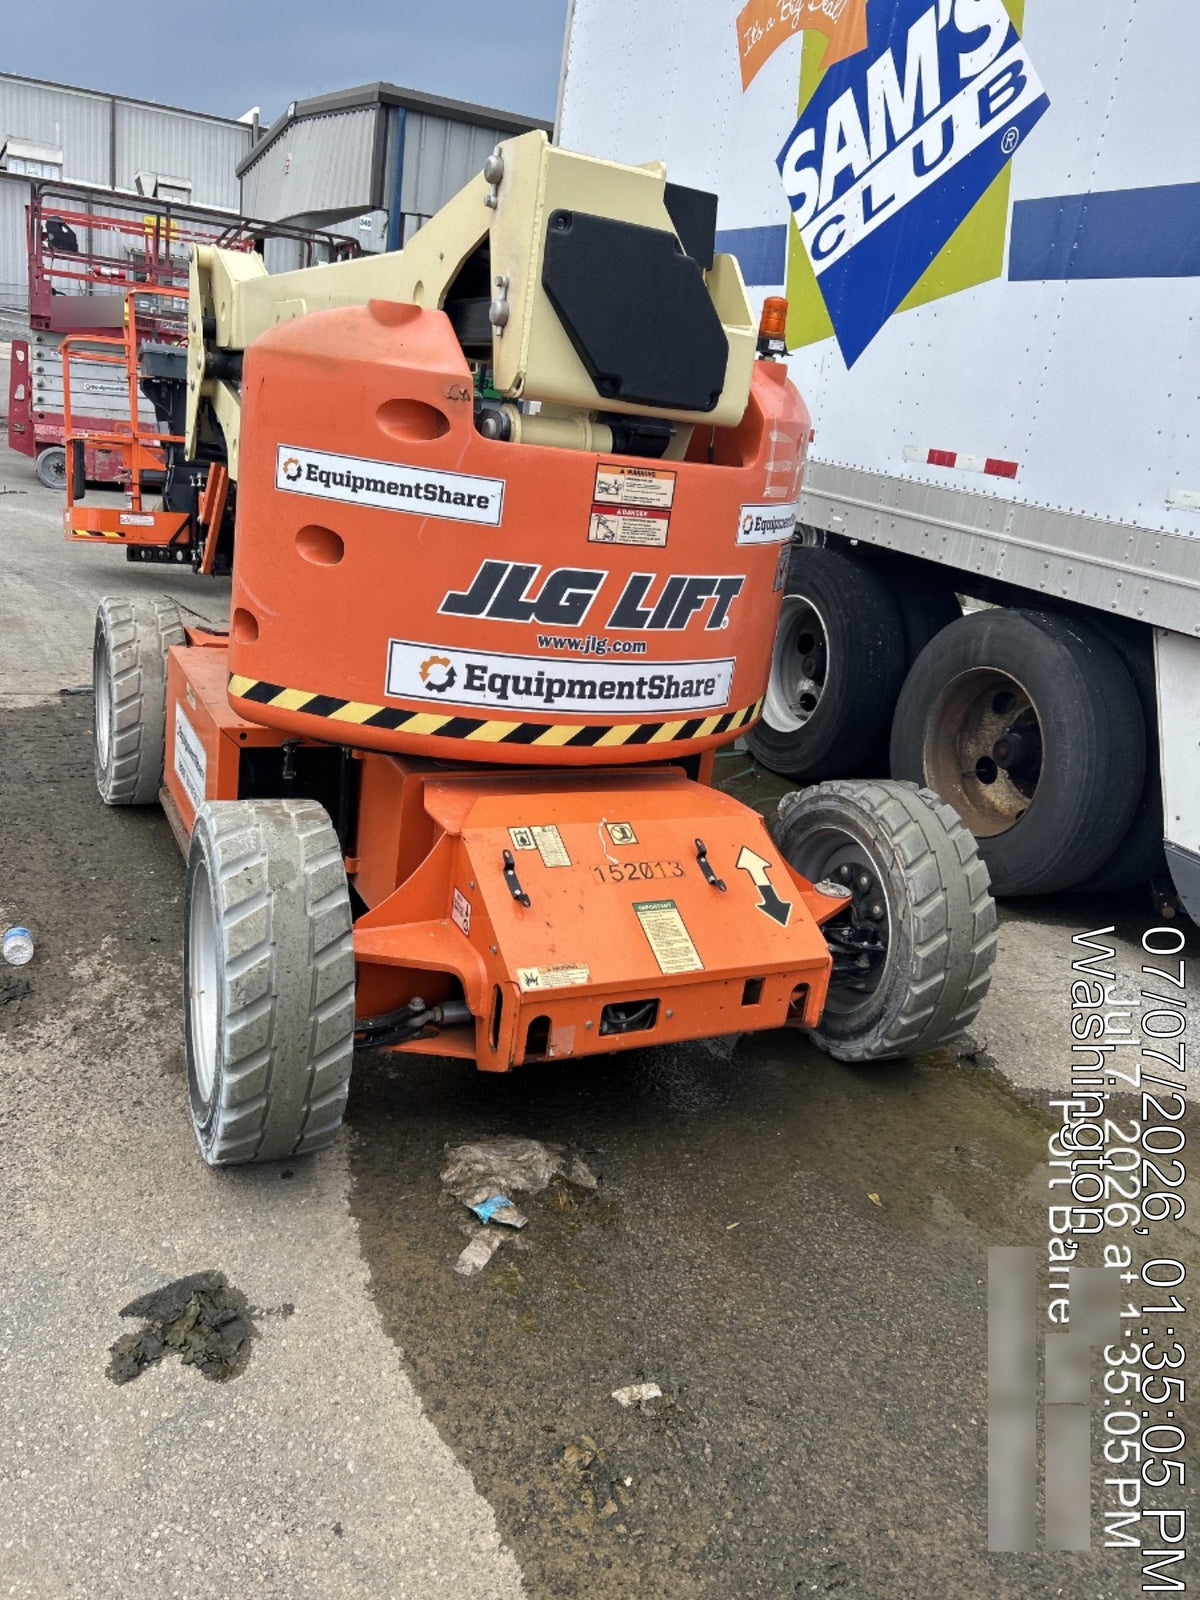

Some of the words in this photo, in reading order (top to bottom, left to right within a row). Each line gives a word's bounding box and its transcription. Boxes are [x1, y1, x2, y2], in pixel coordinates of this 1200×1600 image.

[782, 0, 1010, 230] SAM'S
[811, 59, 1027, 261] CLUB
[305, 463, 490, 510] EquipmentShare
[438, 559, 608, 627] JLG
[605, 571, 746, 631] LIFT
[537, 634, 647, 655] www.jlg.com
[464, 663, 716, 703] EquipmentShare
